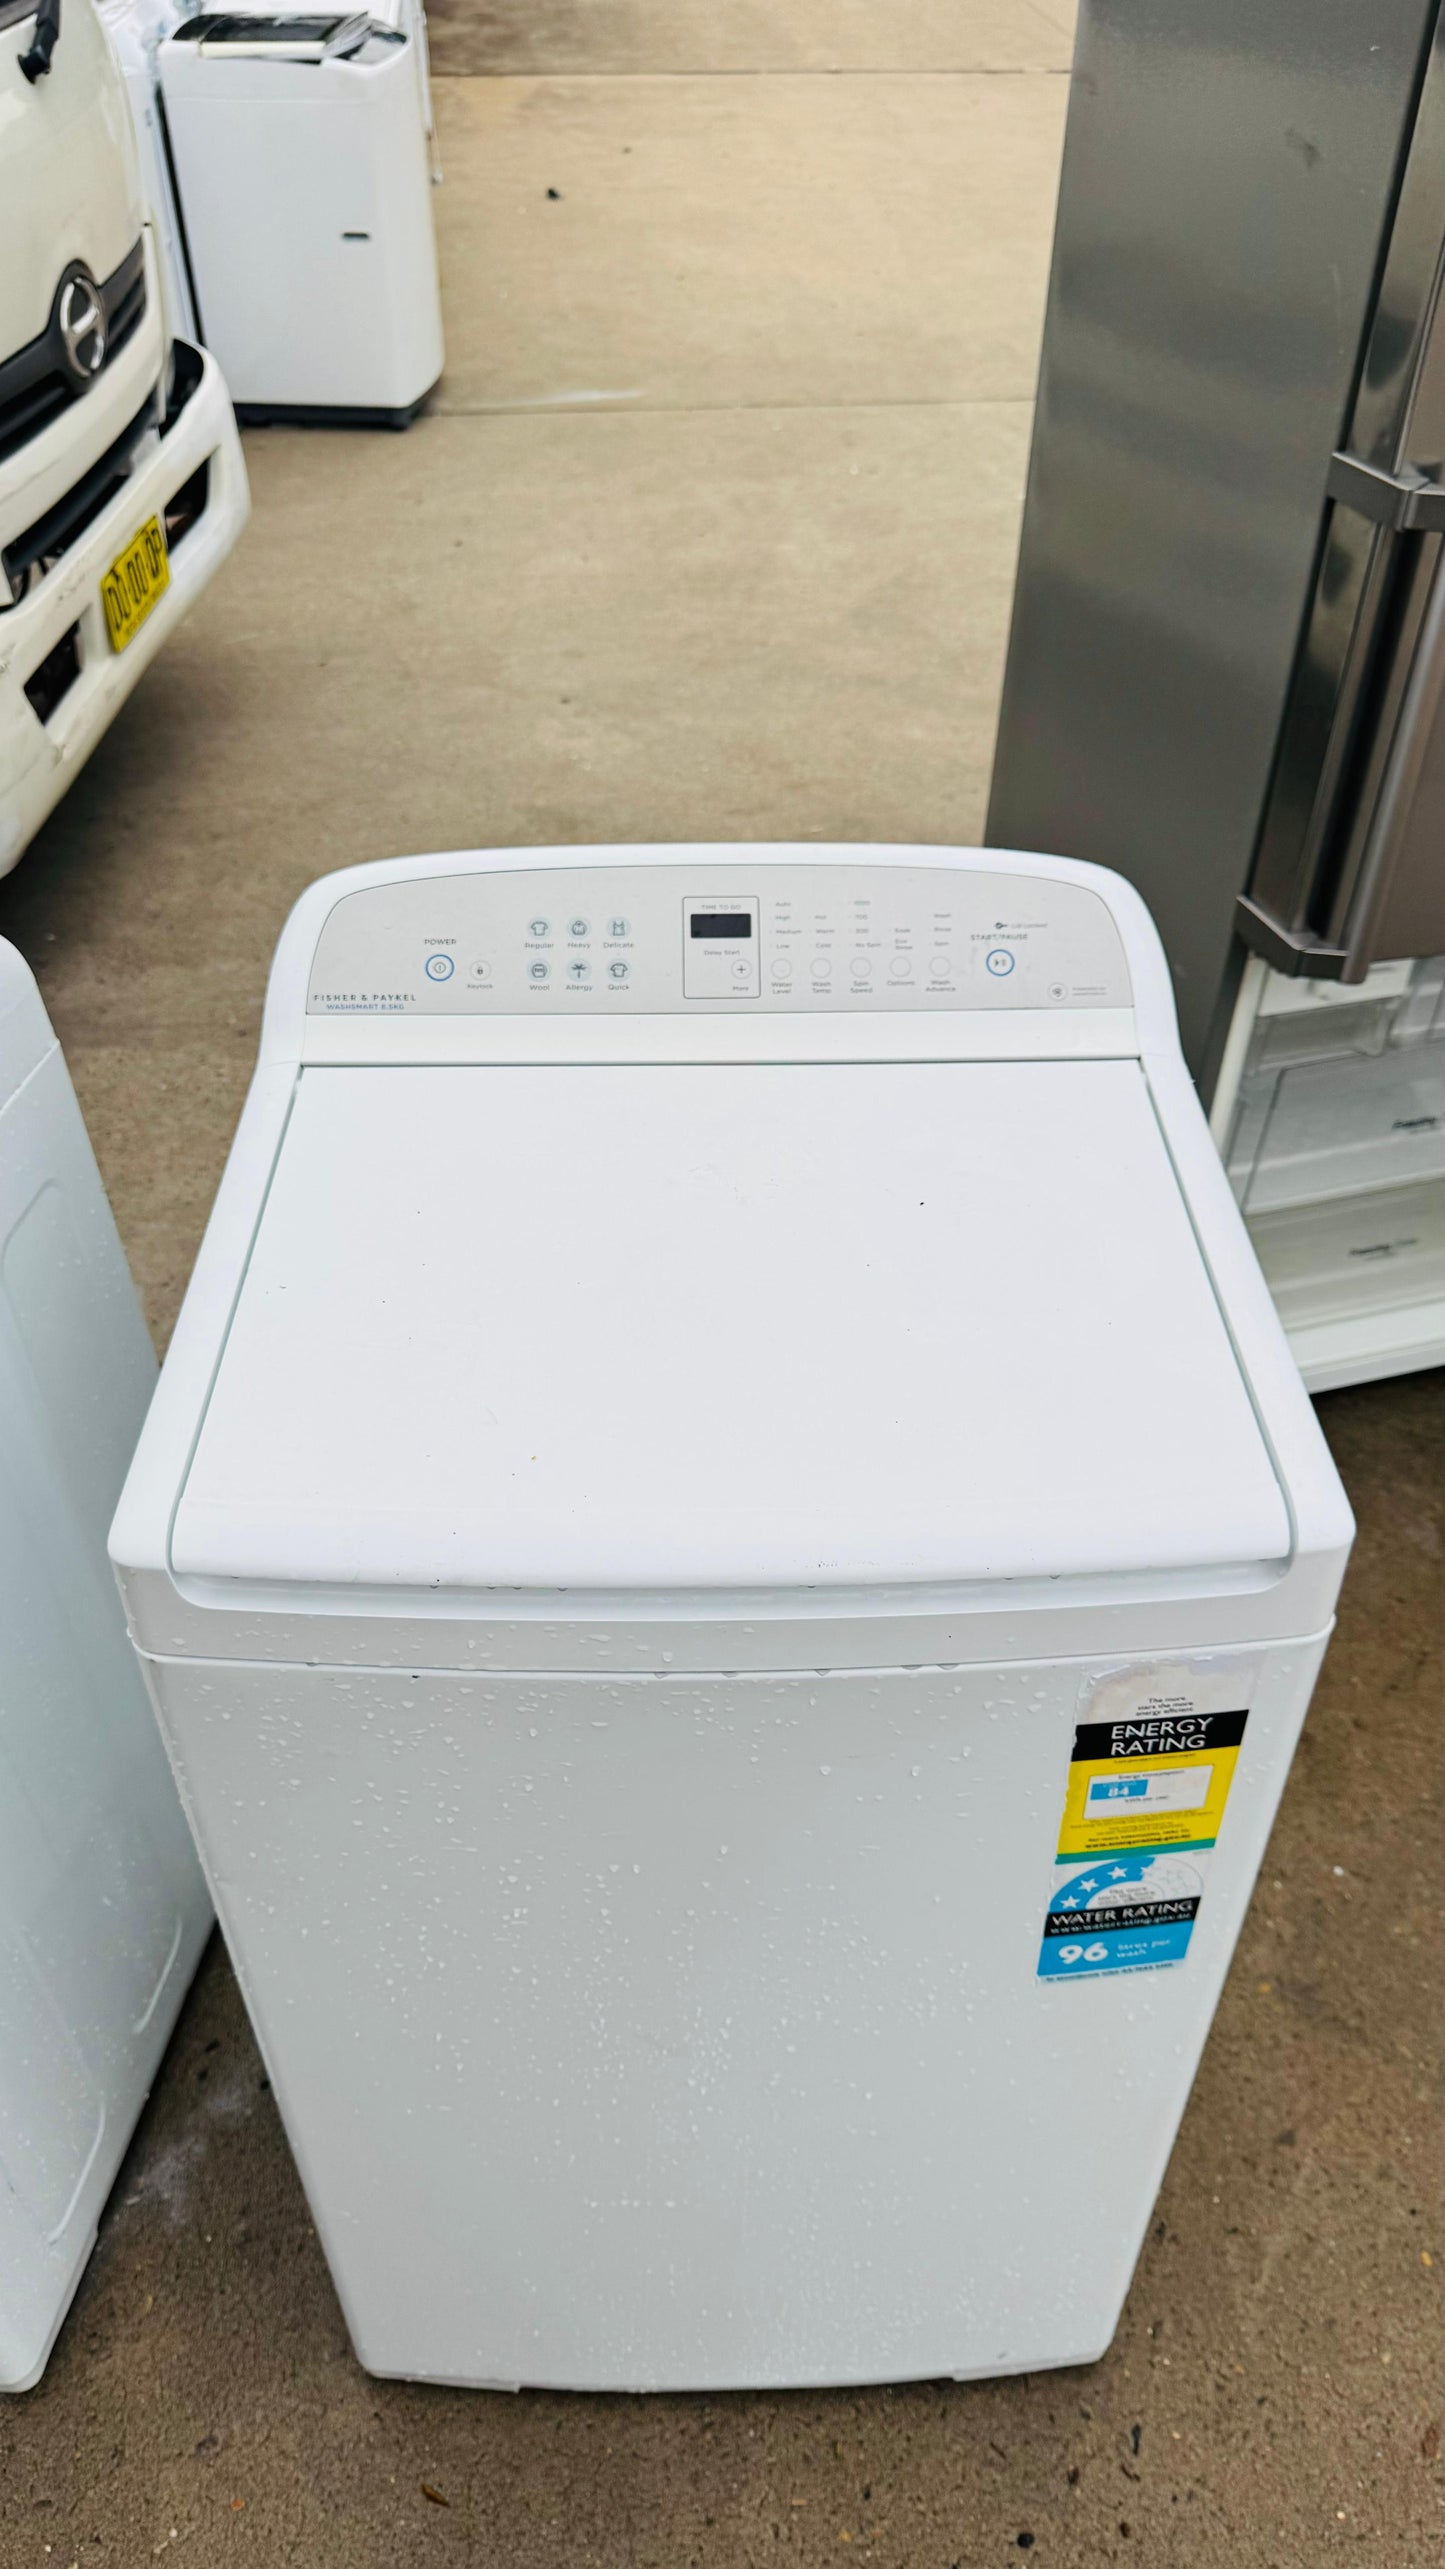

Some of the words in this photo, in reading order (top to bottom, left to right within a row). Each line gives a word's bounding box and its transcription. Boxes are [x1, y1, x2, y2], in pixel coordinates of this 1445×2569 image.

[970, 933, 1028, 941] START/PAUSE
[424, 938, 457, 946] POWER
[524, 942, 554, 950] Regular
[567, 942, 591, 950] Heavy
[603, 941, 634, 949] Delicate
[566, 984, 593, 992] Allergy
[314, 994, 357, 1002] FISHER
[361, 994, 368, 1002] &
[373, 994, 416, 1002] PAYKEL
[1111, 1717, 1214, 1740] ENERGY
[1111, 1735, 1206, 1756] RATING
[1051, 1909, 1117, 1926] WATER
[1122, 1900, 1193, 1918] RATING
[1117, 1942, 1148, 1951] litres
[1151, 1939, 1171, 1948] per
[1058, 1941, 1109, 1965] 96
[1116, 1948, 1147, 1958] wash
